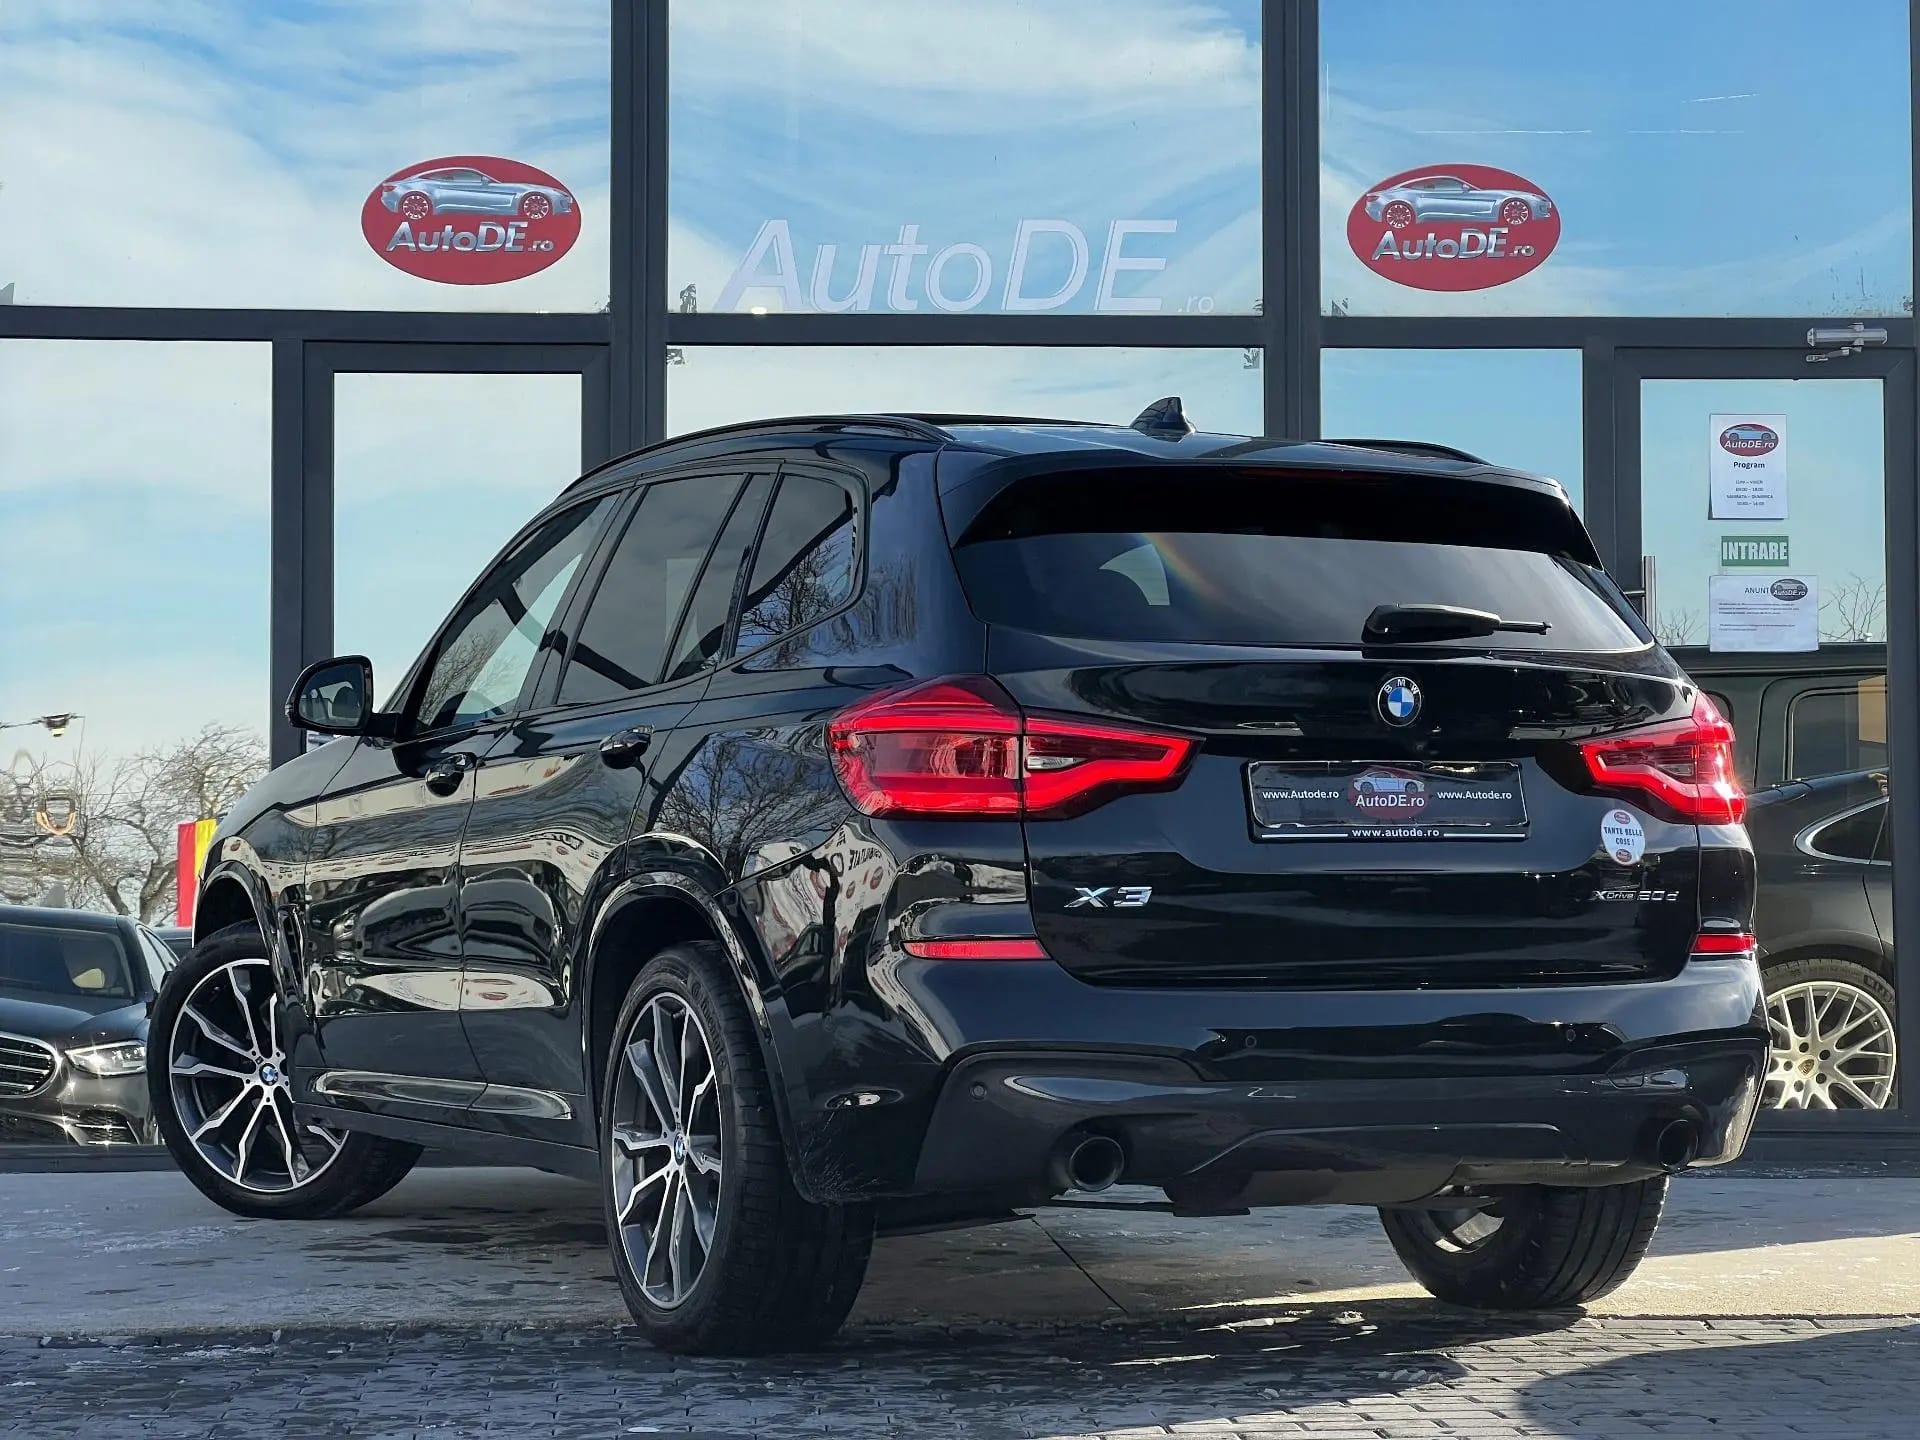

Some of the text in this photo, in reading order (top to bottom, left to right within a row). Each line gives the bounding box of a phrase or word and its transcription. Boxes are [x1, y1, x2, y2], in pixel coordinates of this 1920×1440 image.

[1723, 440, 1775, 449] AutoDE.ro
[1733, 461, 1765, 469] Program
[1722, 542, 1788, 560] INTRARE
[1383, 679, 1420, 695] BMW
[1262, 789, 1512, 807] www.Autode.ro AutoDE.ro www.Autode.ro
[1352, 828, 1440, 837] www.autode.ro
[1063, 886, 1153, 908] X3
